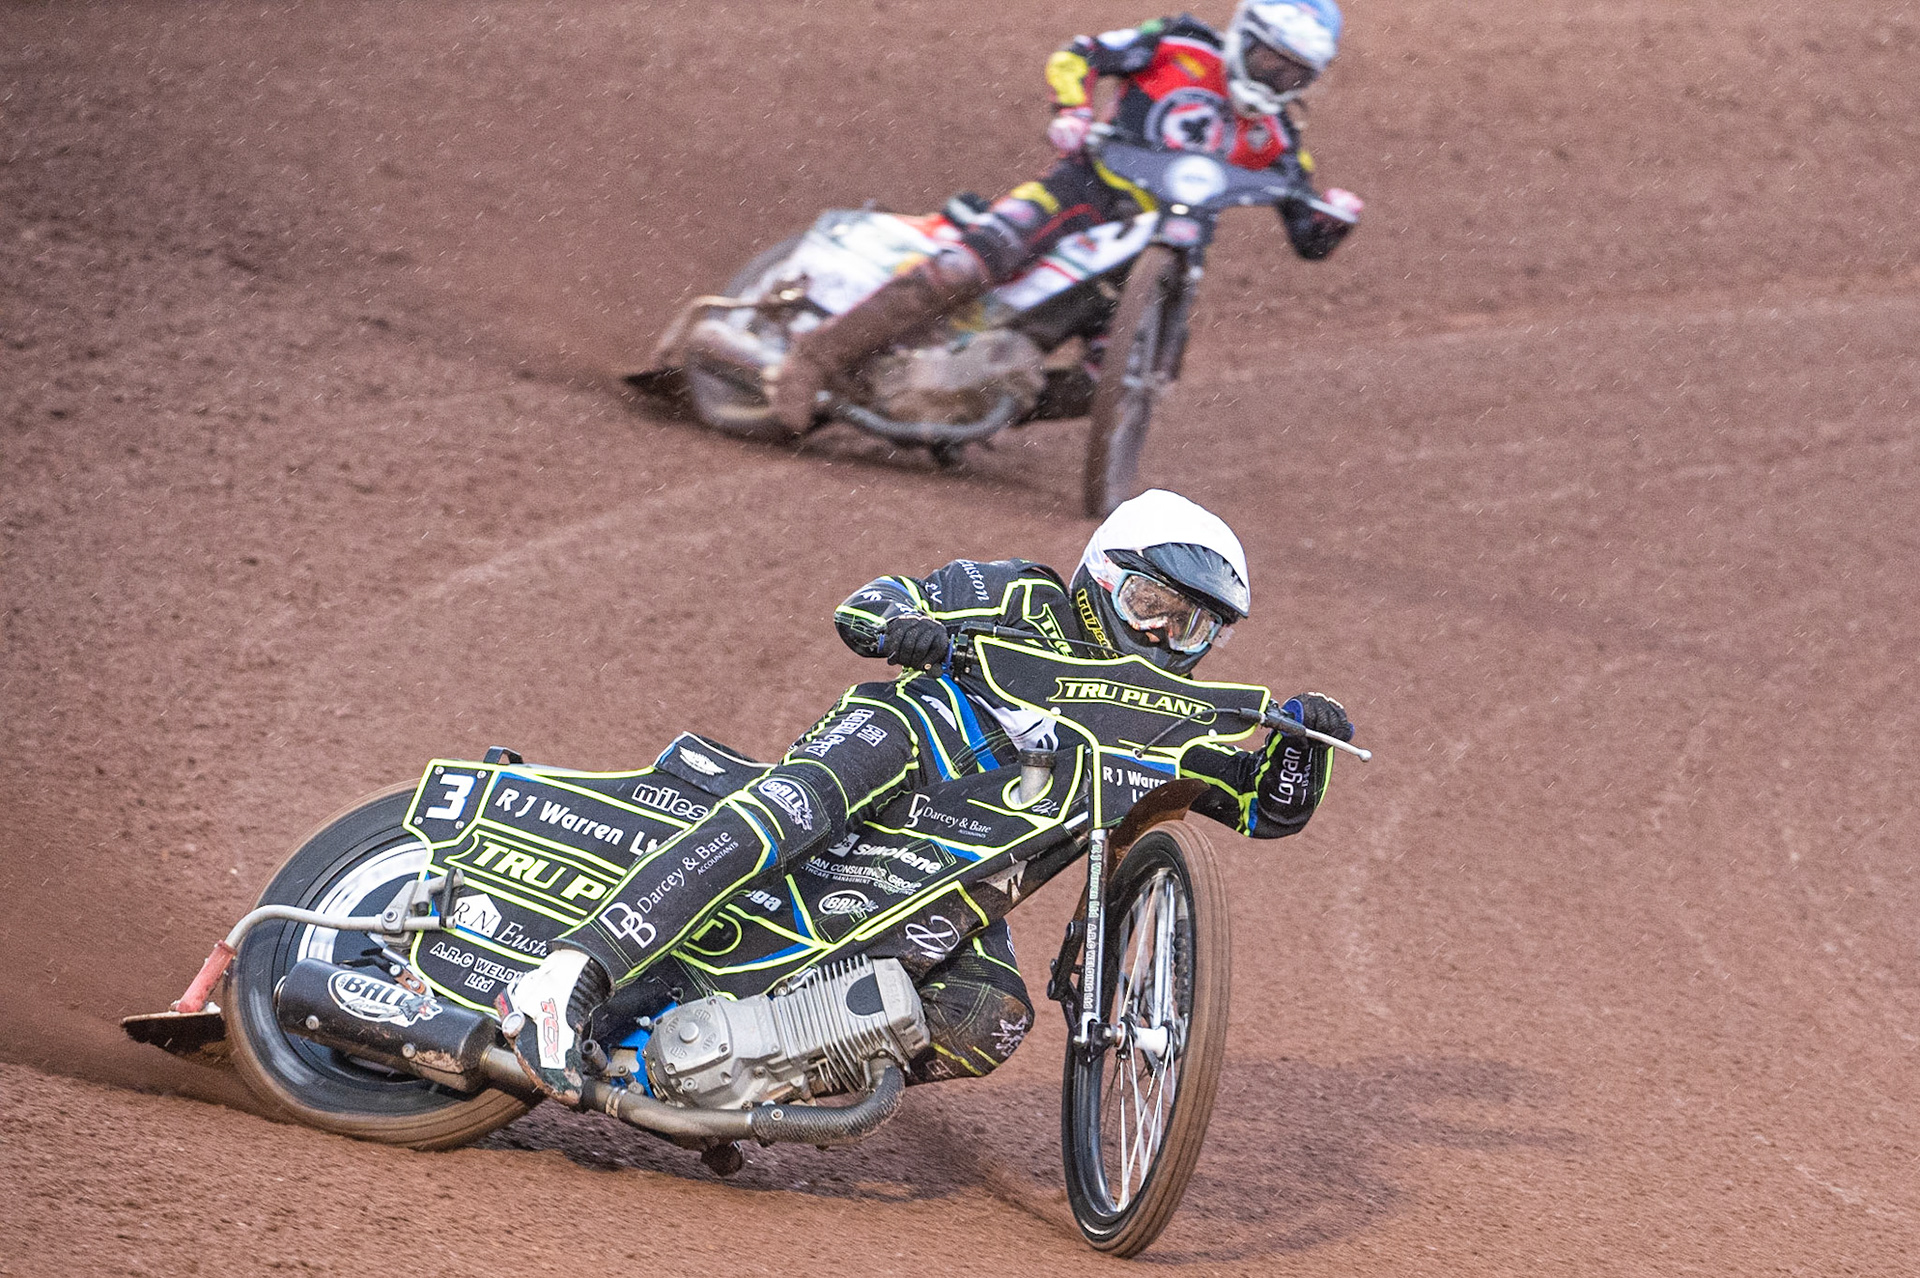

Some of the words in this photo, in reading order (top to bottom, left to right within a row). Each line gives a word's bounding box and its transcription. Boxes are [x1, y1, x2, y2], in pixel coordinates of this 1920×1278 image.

[1065, 683, 1118, 699] TRU
[1121, 689, 1209, 719] PLANT
[1103, 766, 1113, 782] R
[1117, 769, 1123, 786] J
[1270, 747, 1302, 804] Logan
[425, 774, 476, 820] 3
[631, 783, 709, 820] miles
[495, 788, 520, 811] R
[514, 795, 537, 818] J
[539, 800, 624, 846] Warren
[923, 806, 958, 828] Darcey
[958, 818, 969, 829] &
[970, 821, 992, 833] Bate
[474, 840, 566, 889] TRU
[560, 873, 614, 901] P
[637, 868, 685, 914] Darcey
[682, 856, 700, 871] &
[695, 832, 732, 860] Bate
[697, 841, 739, 875] ACCOUNTANTS
[465, 973, 495, 993] Ltd
[1084, 950, 1097, 992] WELDING
